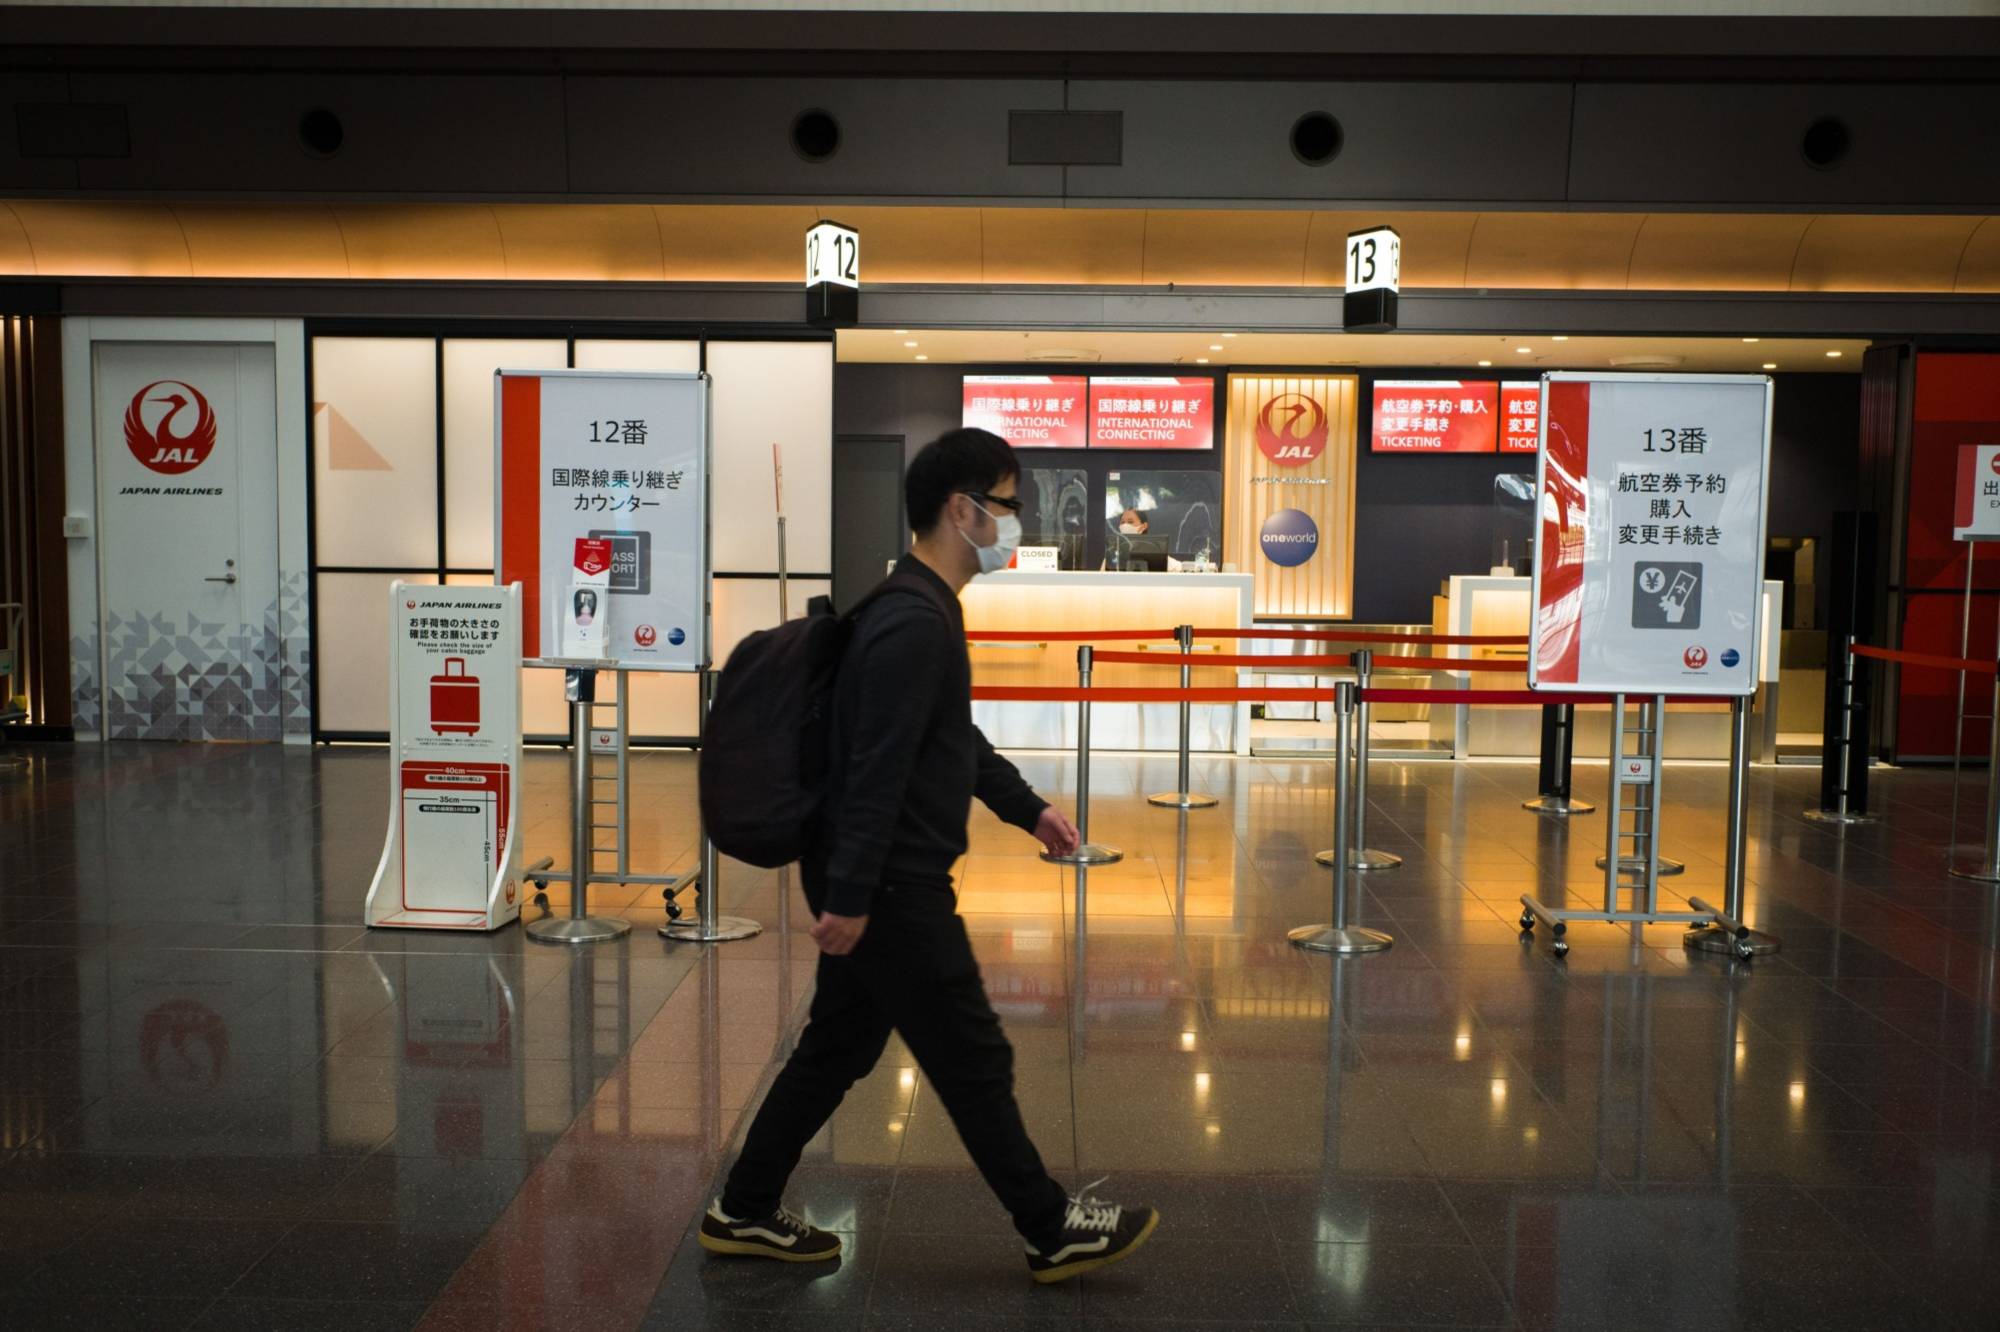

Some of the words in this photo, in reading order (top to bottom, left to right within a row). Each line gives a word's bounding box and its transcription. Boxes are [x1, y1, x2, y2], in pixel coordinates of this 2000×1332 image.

[834, 234, 857, 281] 12
[1350, 238, 1377, 284] 13
[1097, 418, 1194, 429] INTERNATIONAL
[589, 419, 648, 445] 12番
[1097, 429, 1175, 441] CONNECTING
[1381, 436, 1441, 448] TICKETING
[1642, 427, 1707, 454] 13番
[149, 447, 199, 463] JAL
[1274, 446, 1314, 458] JAL
[552, 468, 684, 490] 国際線乗り継ぎ
[1618, 472, 1726, 494] 航空券予約
[120, 487, 160, 495] JAPAN
[163, 487, 223, 495] AIRLINES
[1984, 480, 1999, 496] 出
[574, 493, 660, 512] カウンター
[1650, 498, 1692, 519] 購入
[1262, 531, 1317, 544] oneworld
[1618, 524, 1722, 545] 変更手続き
[611, 552, 635, 562] ASS
[1020, 550, 1053, 558] CLOSED
[611, 563, 636, 573] ORT
[409, 618, 500, 628] お手荷物の大きさの
[409, 629, 500, 640] 確認をお願いします
[439, 795, 460, 803] 35cm
